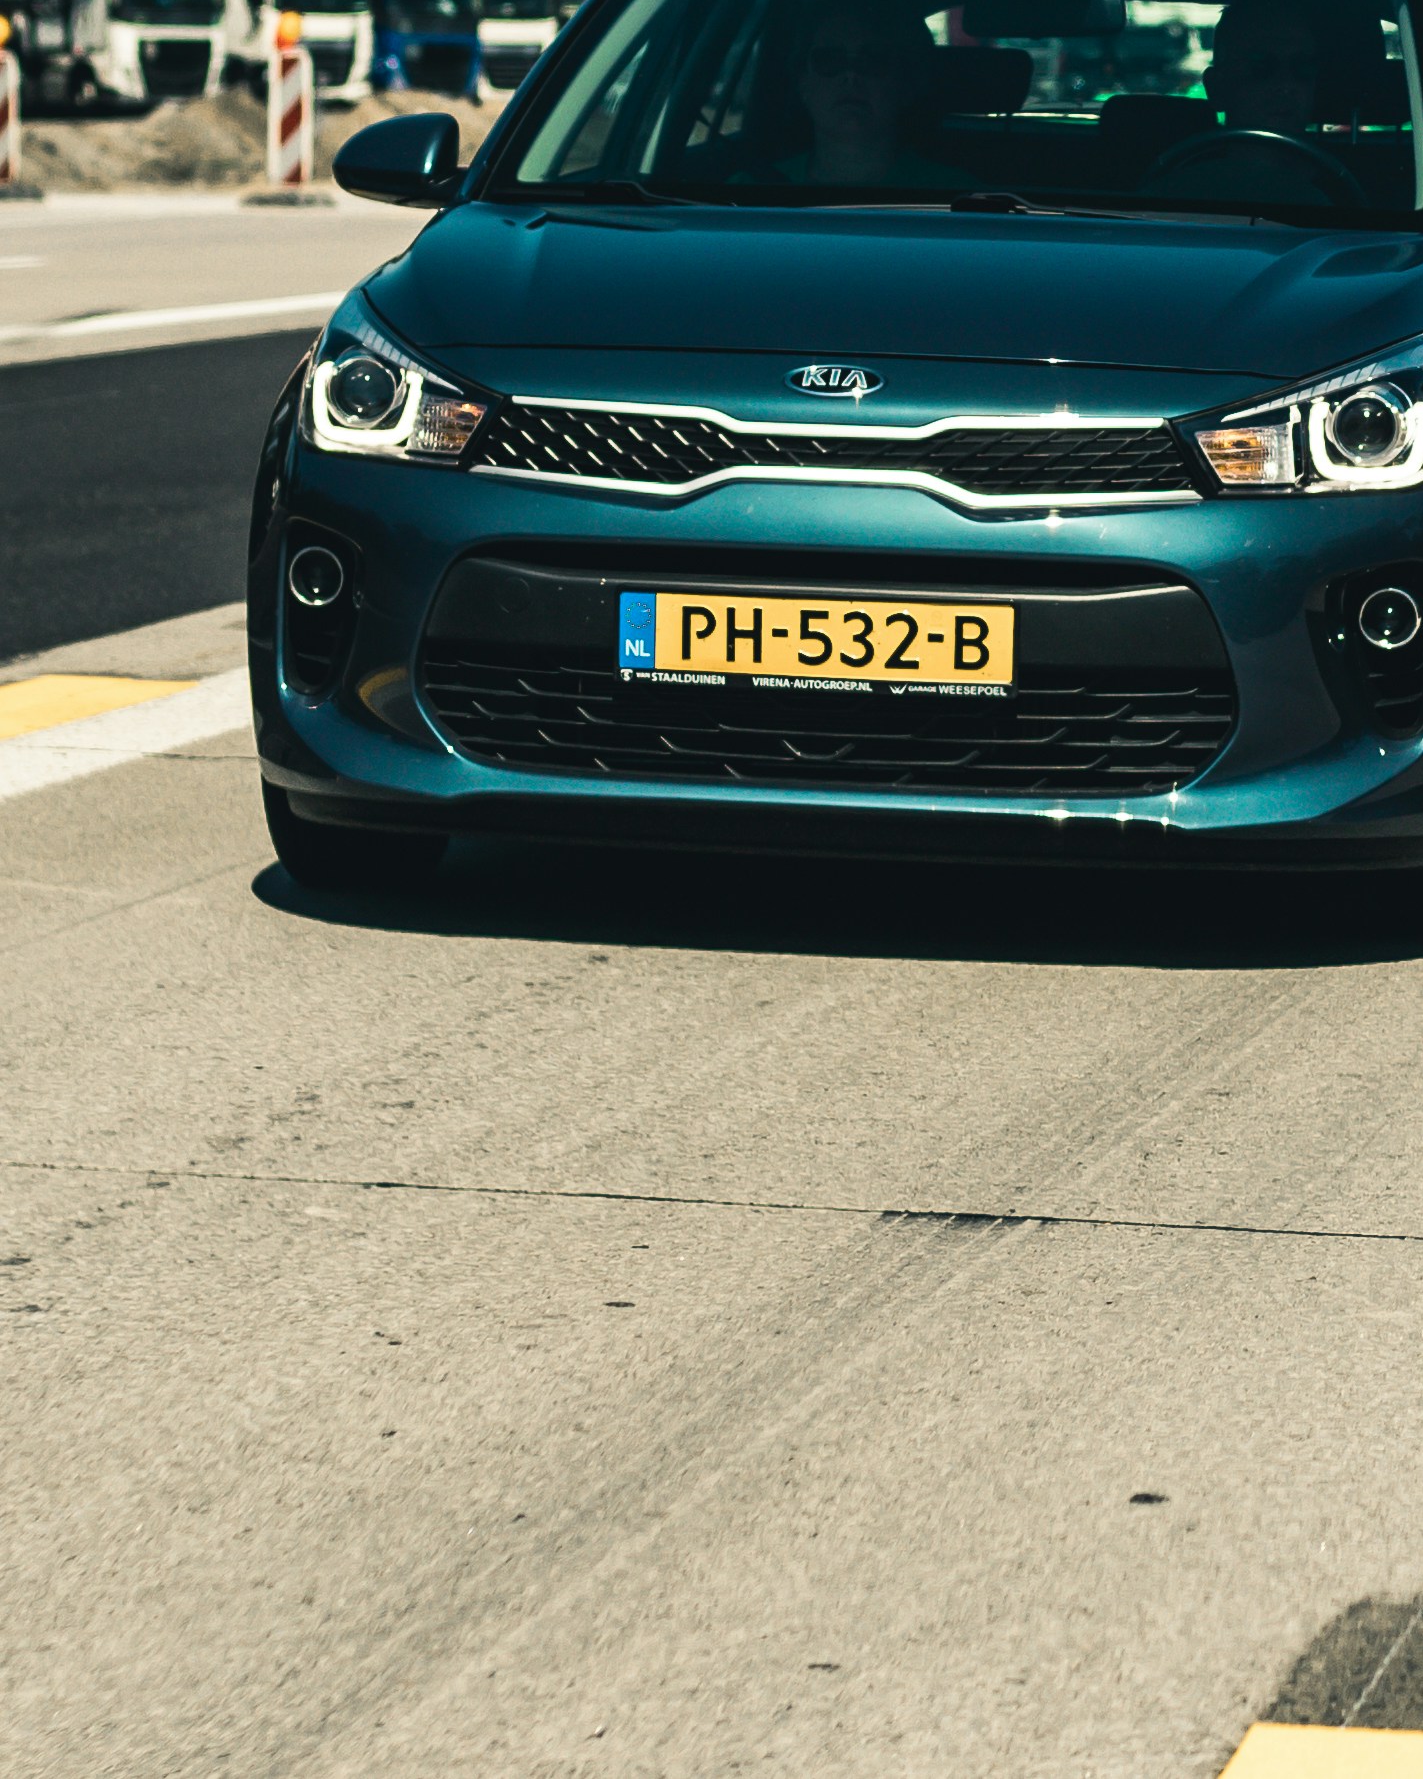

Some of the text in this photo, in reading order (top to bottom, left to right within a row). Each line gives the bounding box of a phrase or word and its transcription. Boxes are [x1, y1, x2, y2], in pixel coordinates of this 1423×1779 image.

[801, 368, 868, 389] KIA
[681, 606, 991, 670] PH-532-B
[624, 639, 651, 658] NL
[651, 672, 726, 685] STAALDUINEN
[938, 684, 1007, 697] WEESEPOEL
